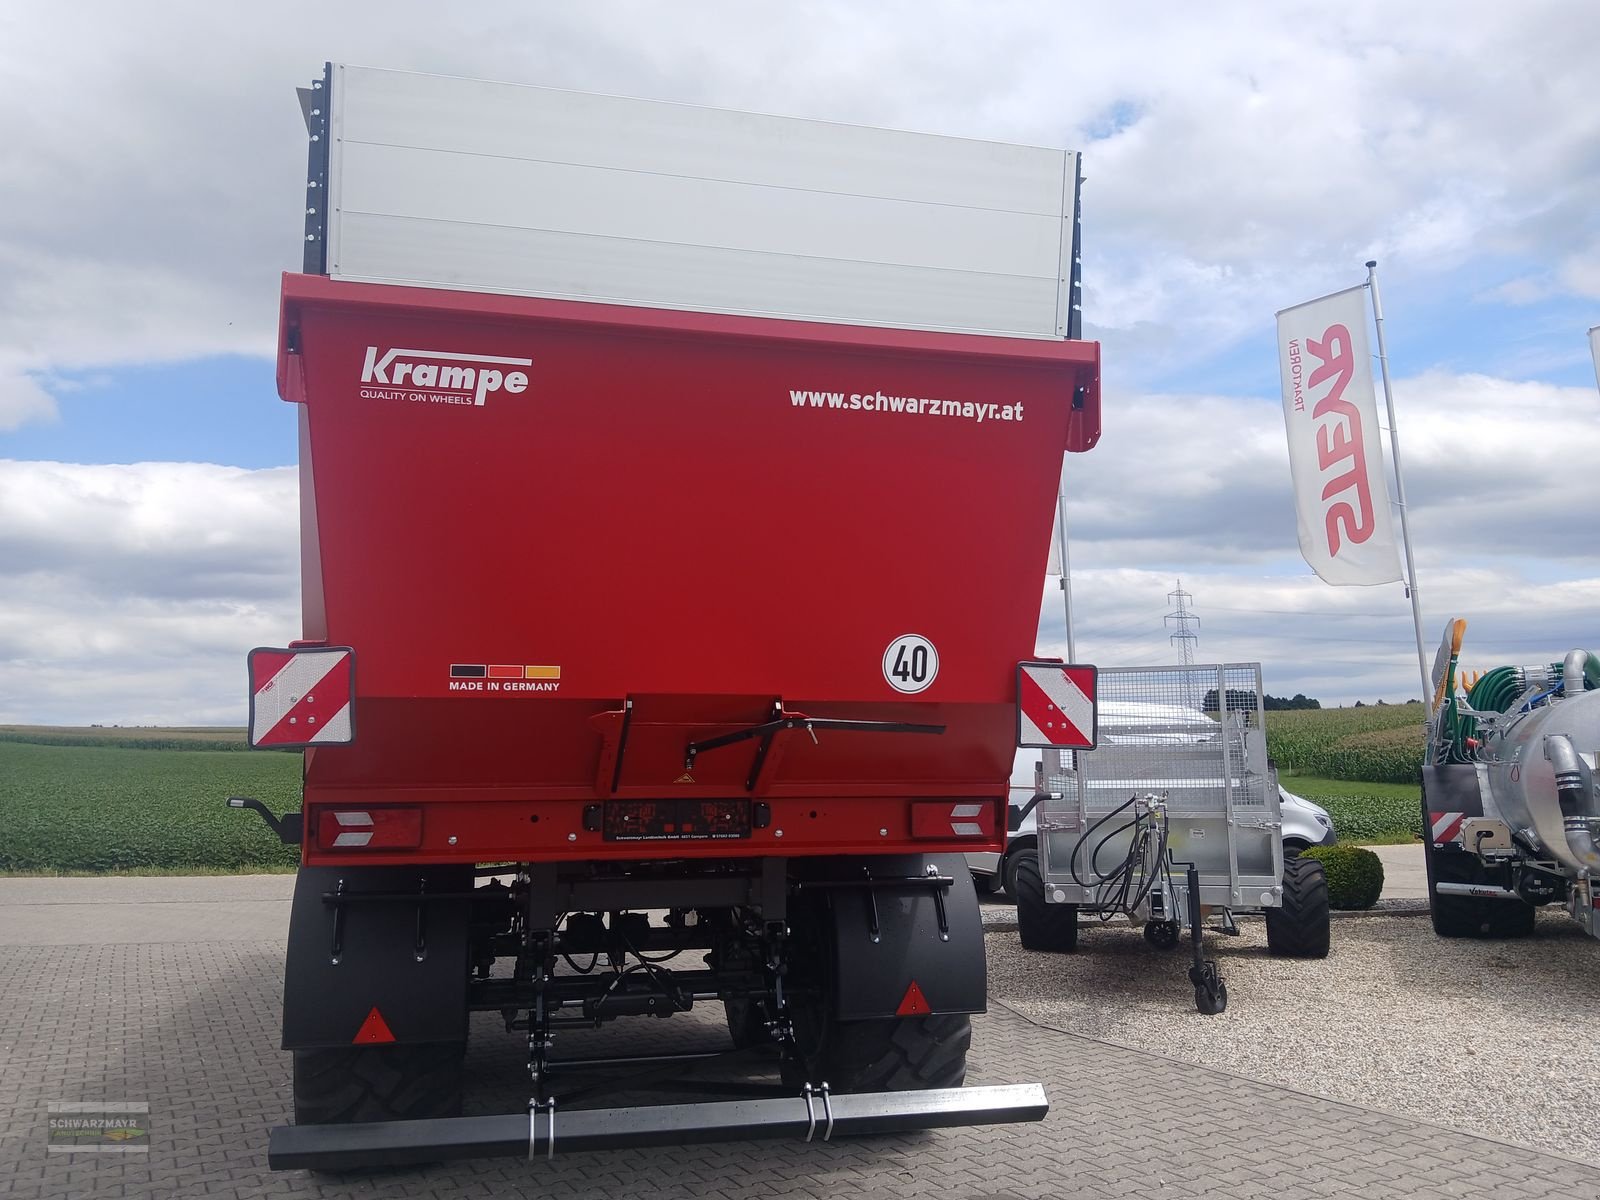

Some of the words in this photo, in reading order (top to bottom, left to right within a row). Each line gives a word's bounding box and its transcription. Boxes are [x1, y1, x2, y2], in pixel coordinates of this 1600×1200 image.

[360, 346, 533, 406] Krampe
[360, 390, 407, 401] QUALITY
[409, 393, 427, 402] ON
[429, 394, 473, 405] WHEELS
[789, 390, 1024, 423] www.schwarzmayr.at
[892, 644, 928, 682] 40
[449, 682, 483, 691] MADE
[487, 682, 500, 691] IN
[503, 682, 560, 691] GERMANY
